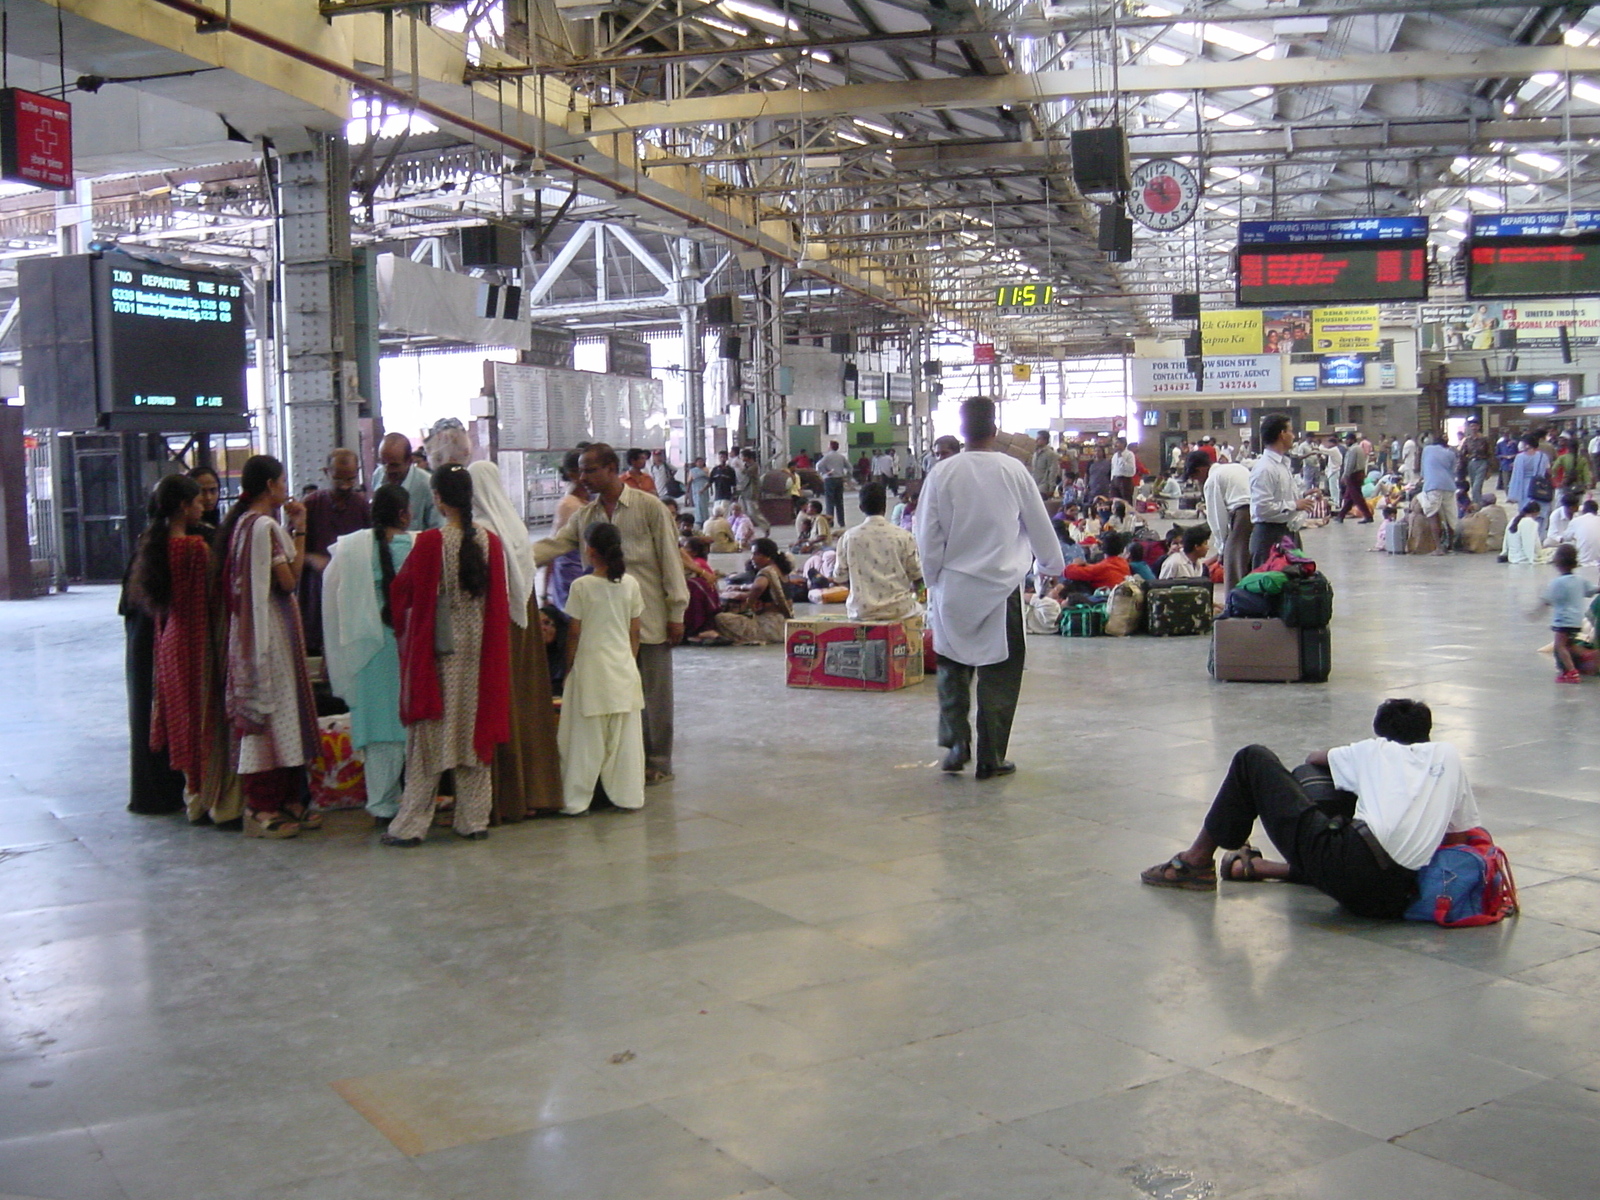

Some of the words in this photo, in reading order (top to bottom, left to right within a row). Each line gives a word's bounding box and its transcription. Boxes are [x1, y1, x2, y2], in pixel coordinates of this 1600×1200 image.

[1145, 166, 1153, 178] 11
[1156, 163, 1167, 175] 12
[1135, 177, 1145, 188] 10
[1181, 174, 1189, 186] 2
[1131, 190, 1140, 202] 9
[1186, 188, 1194, 199] 3
[1136, 204, 1145, 215] 8
[1181, 202, 1189, 213] 4
[1147, 212, 1155, 222] 7
[1159, 214, 1168, 225] 6
[1171, 211, 1180, 222] 5
[1267, 223, 1300, 233] ARRIVING
[142, 274, 190, 291] DEPARTURE
[230, 286, 240, 297] ST
[1015, 306, 1048, 314] TITAN
[1525, 310, 1554, 318] UNITED
[1202, 320, 1213, 329] Ek
[1217, 320, 1242, 329] Ghar
[1243, 319, 1258, 328] Ho
[1230, 335, 1245, 343] Ka
[1152, 361, 1169, 370] FOR
[1171, 361, 1187, 370] THI
[1216, 360, 1236, 368] SIGN
[1238, 358, 1257, 367] SITE
[1152, 372, 1183, 380] CONTACT
[1244, 369, 1271, 378] AGENCY
[1219, 380, 1258, 390] 3427454
